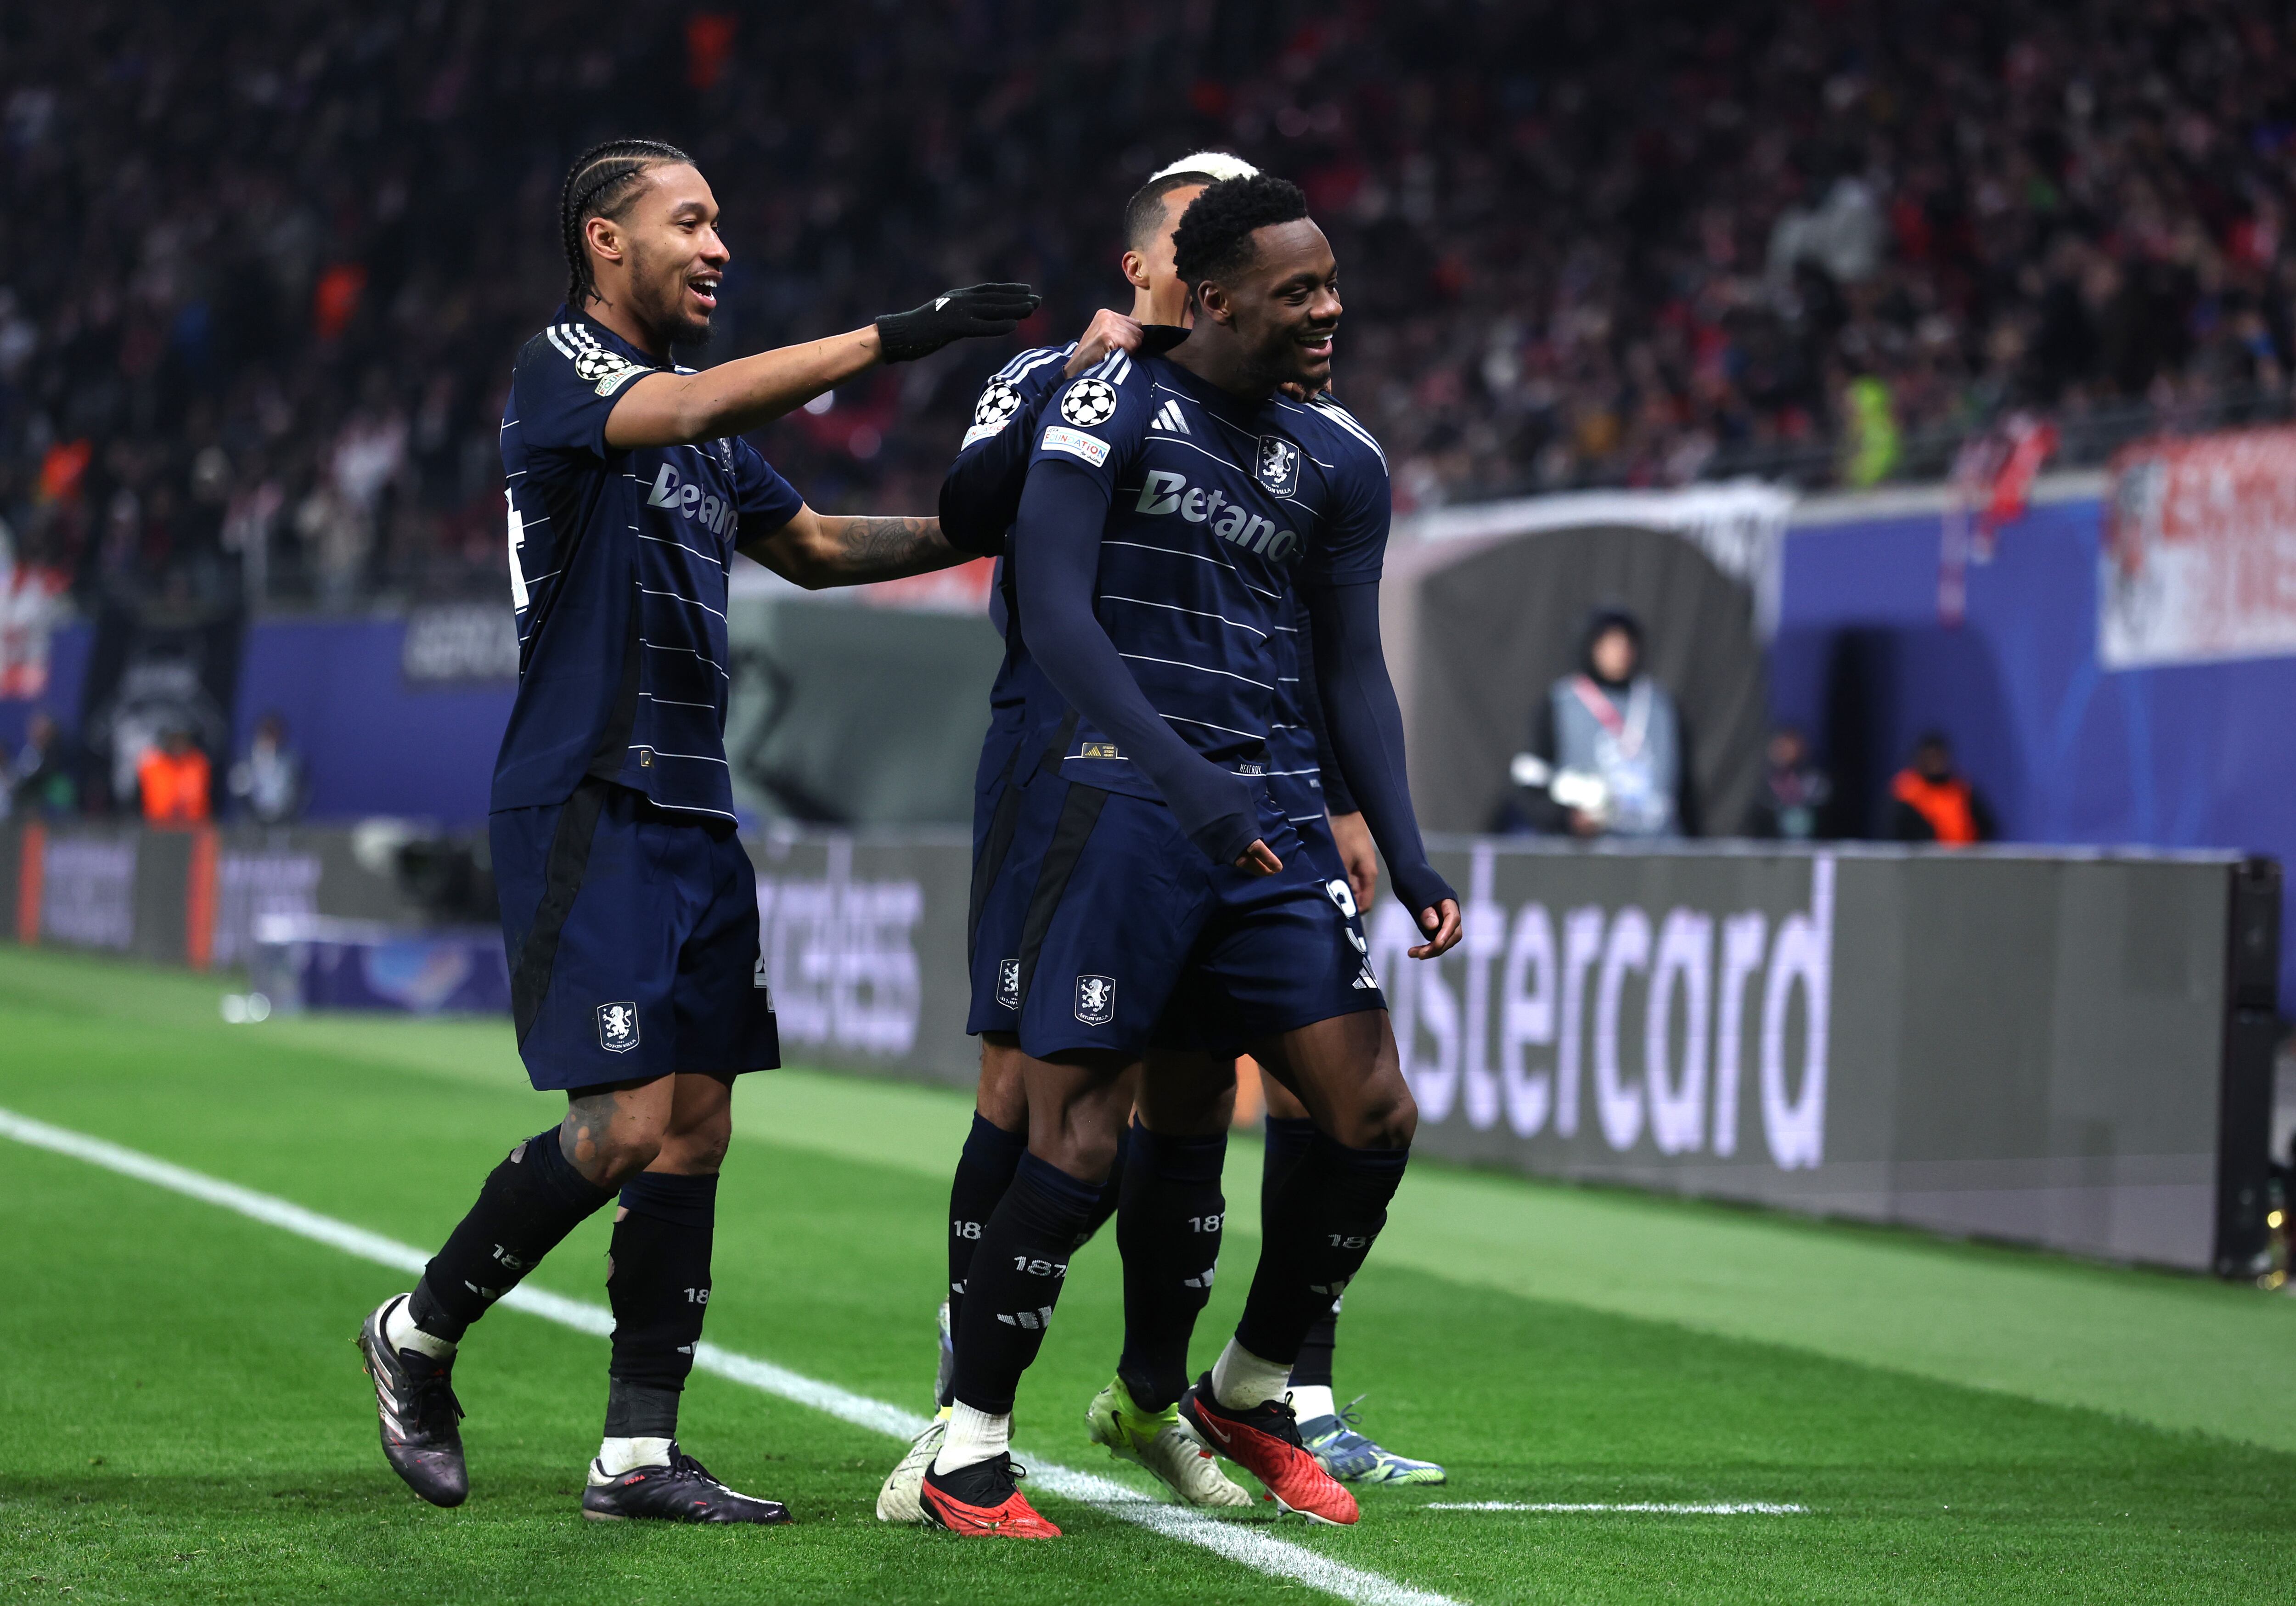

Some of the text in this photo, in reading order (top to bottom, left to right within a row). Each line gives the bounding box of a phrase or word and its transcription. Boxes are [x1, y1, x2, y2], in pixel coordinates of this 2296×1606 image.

[1045, 434, 1106, 459] FOUNDATION
[1135, 470, 1297, 562] Betano
[1370, 842, 1835, 1171] astercard
[954, 1220, 987, 1240] 18
[1014, 1256, 1067, 1278] 187
[625, 1475, 645, 1485] COPA
